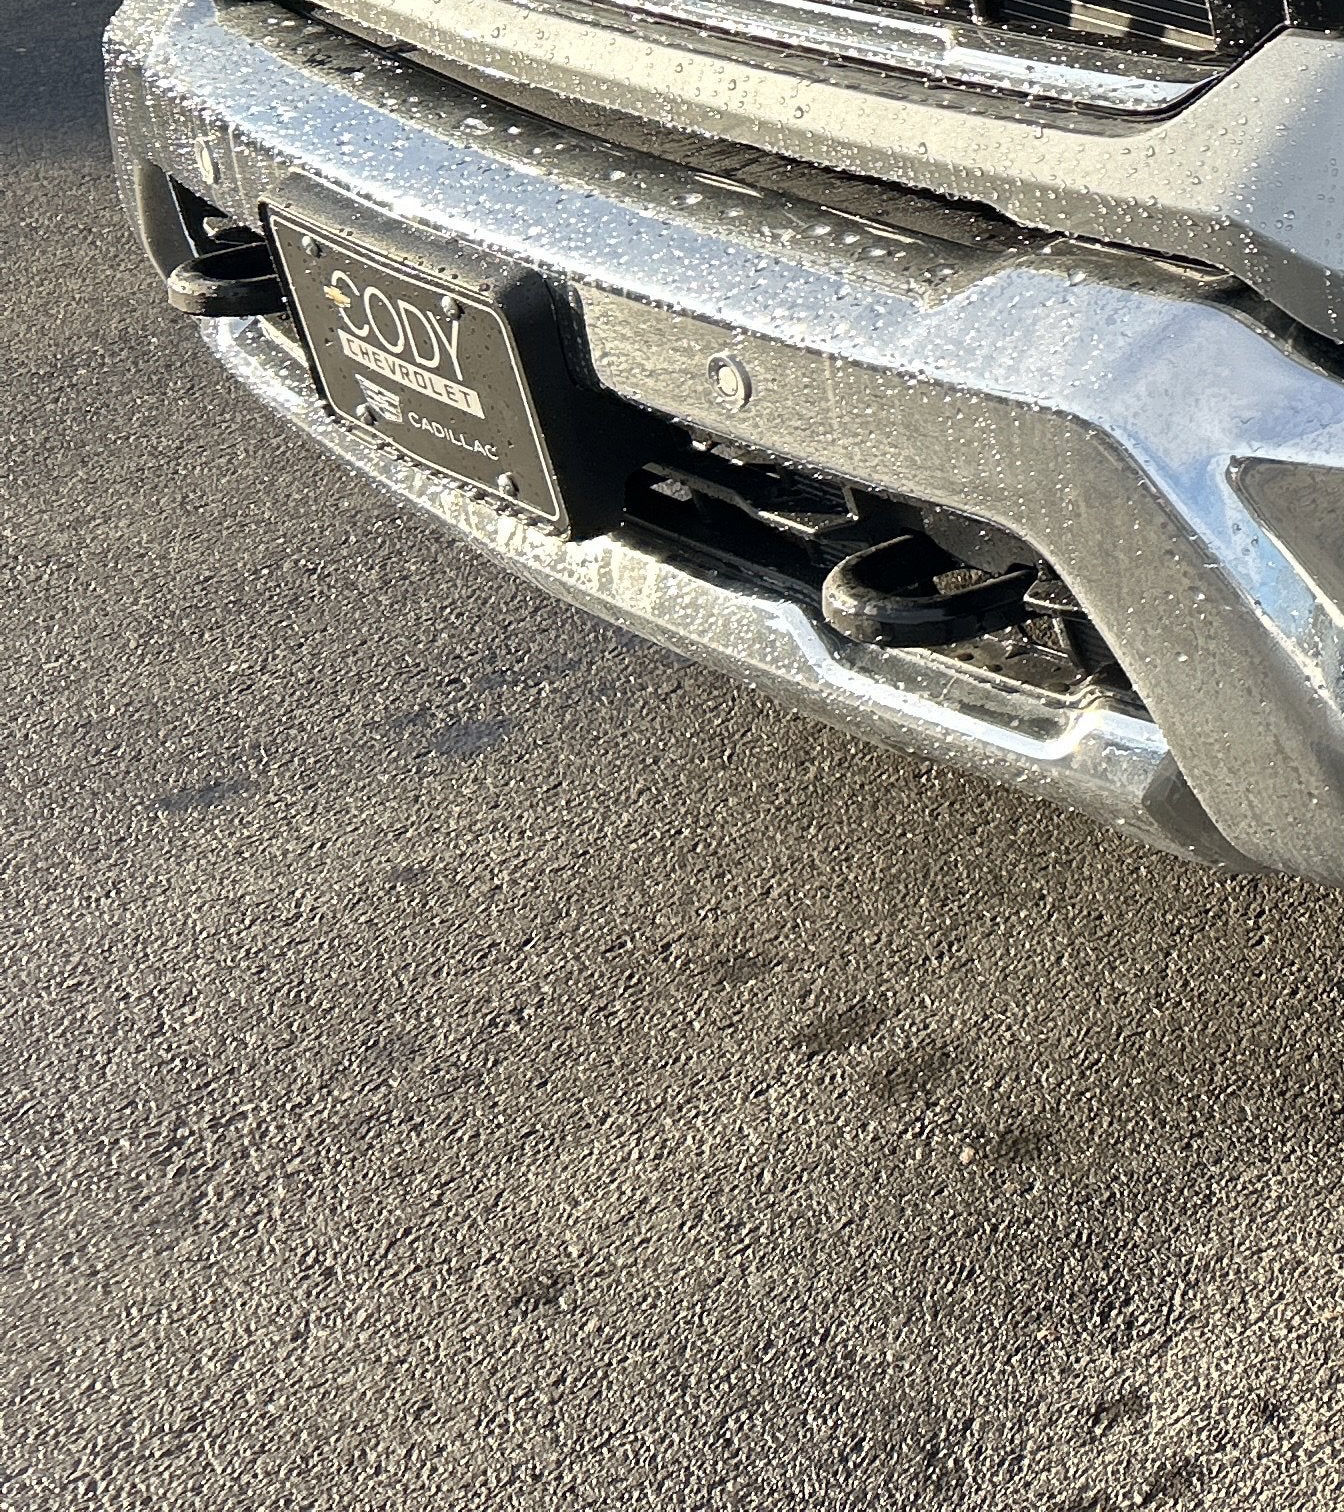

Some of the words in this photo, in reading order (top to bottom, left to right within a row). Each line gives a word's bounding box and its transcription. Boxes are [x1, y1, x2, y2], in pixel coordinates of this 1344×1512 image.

[330, 270, 463, 381] CODY
[346, 337, 474, 410] CHEVROLET
[407, 411, 500, 462] CADILLAC
